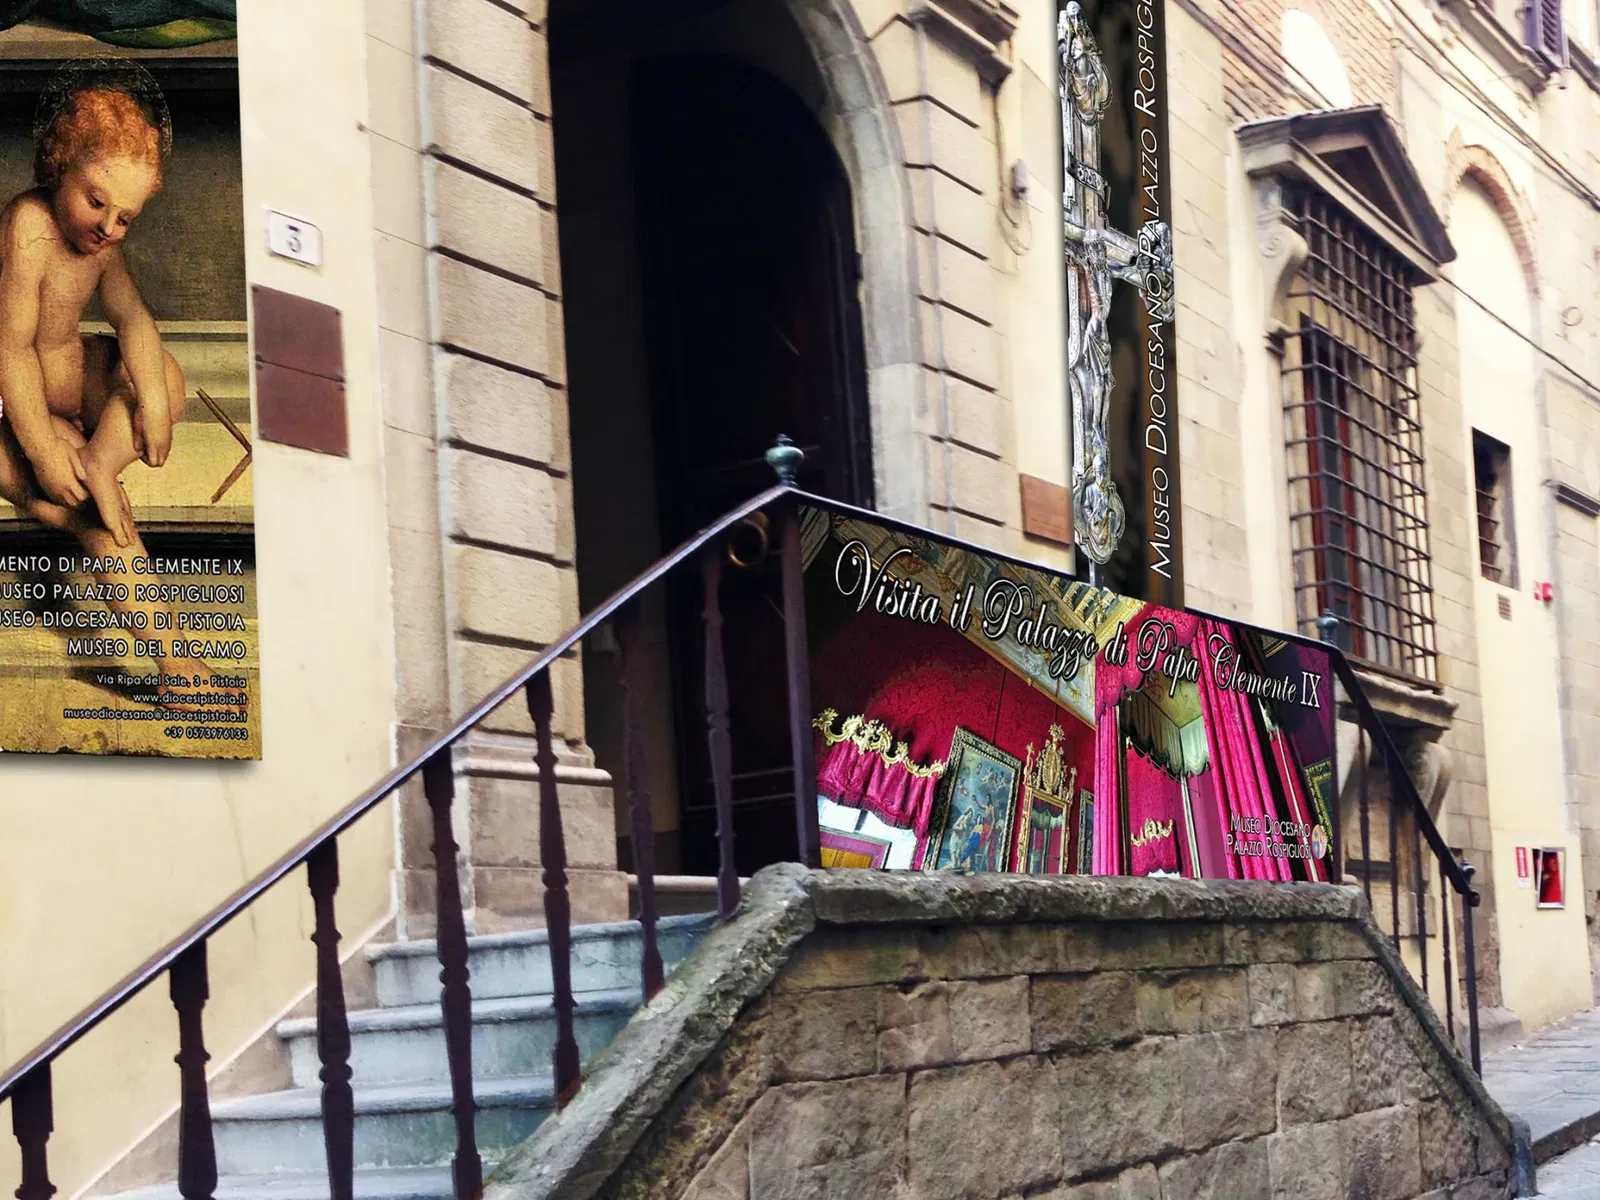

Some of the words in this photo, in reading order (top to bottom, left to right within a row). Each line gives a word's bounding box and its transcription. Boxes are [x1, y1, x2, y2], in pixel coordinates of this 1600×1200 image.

[287, 224, 301, 253] 3
[59, 556, 75, 572] DI
[82, 556, 126, 574] PAPA
[132, 557, 220, 574] CLEMENTE
[227, 558, 243, 575] IX
[0, 583, 46, 599] USEO
[53, 584, 128, 601] PALAZZO
[135, 585, 244, 603] ROSPIGLIOSI
[0, 610, 36, 626] SEO
[43, 611, 147, 628] DIOCESANO
[154, 612, 172, 629] DI
[179, 614, 246, 631] PISTOIA
[836, 541, 941, 625] Visita
[950, 583, 975, 631] il
[982, 579, 1098, 680] Palazzo
[1104, 622, 1128, 666] di
[1137, 618, 1200, 697] Papa
[1208, 633, 1297, 703] Clemente
[1300, 671, 1321, 708] IX
[68, 639, 128, 656] MUSEO
[135, 640, 166, 657] DEL
[173, 641, 246, 659] RICAMO
[97, 674, 114, 685] Via
[117, 674, 141, 687] Ripa
[144, 674, 162, 686] del
[164, 675, 190, 687] Sale,
[193, 676, 200, 687] 3
[210, 676, 246, 688] Pistoia
[133, 692, 247, 706] www.diocesipistoia.it
[63, 707, 247, 723] museodiocesano@diocesipistoia.it
[164, 727, 183, 738] +39
[186, 727, 248, 739] 0573976133
